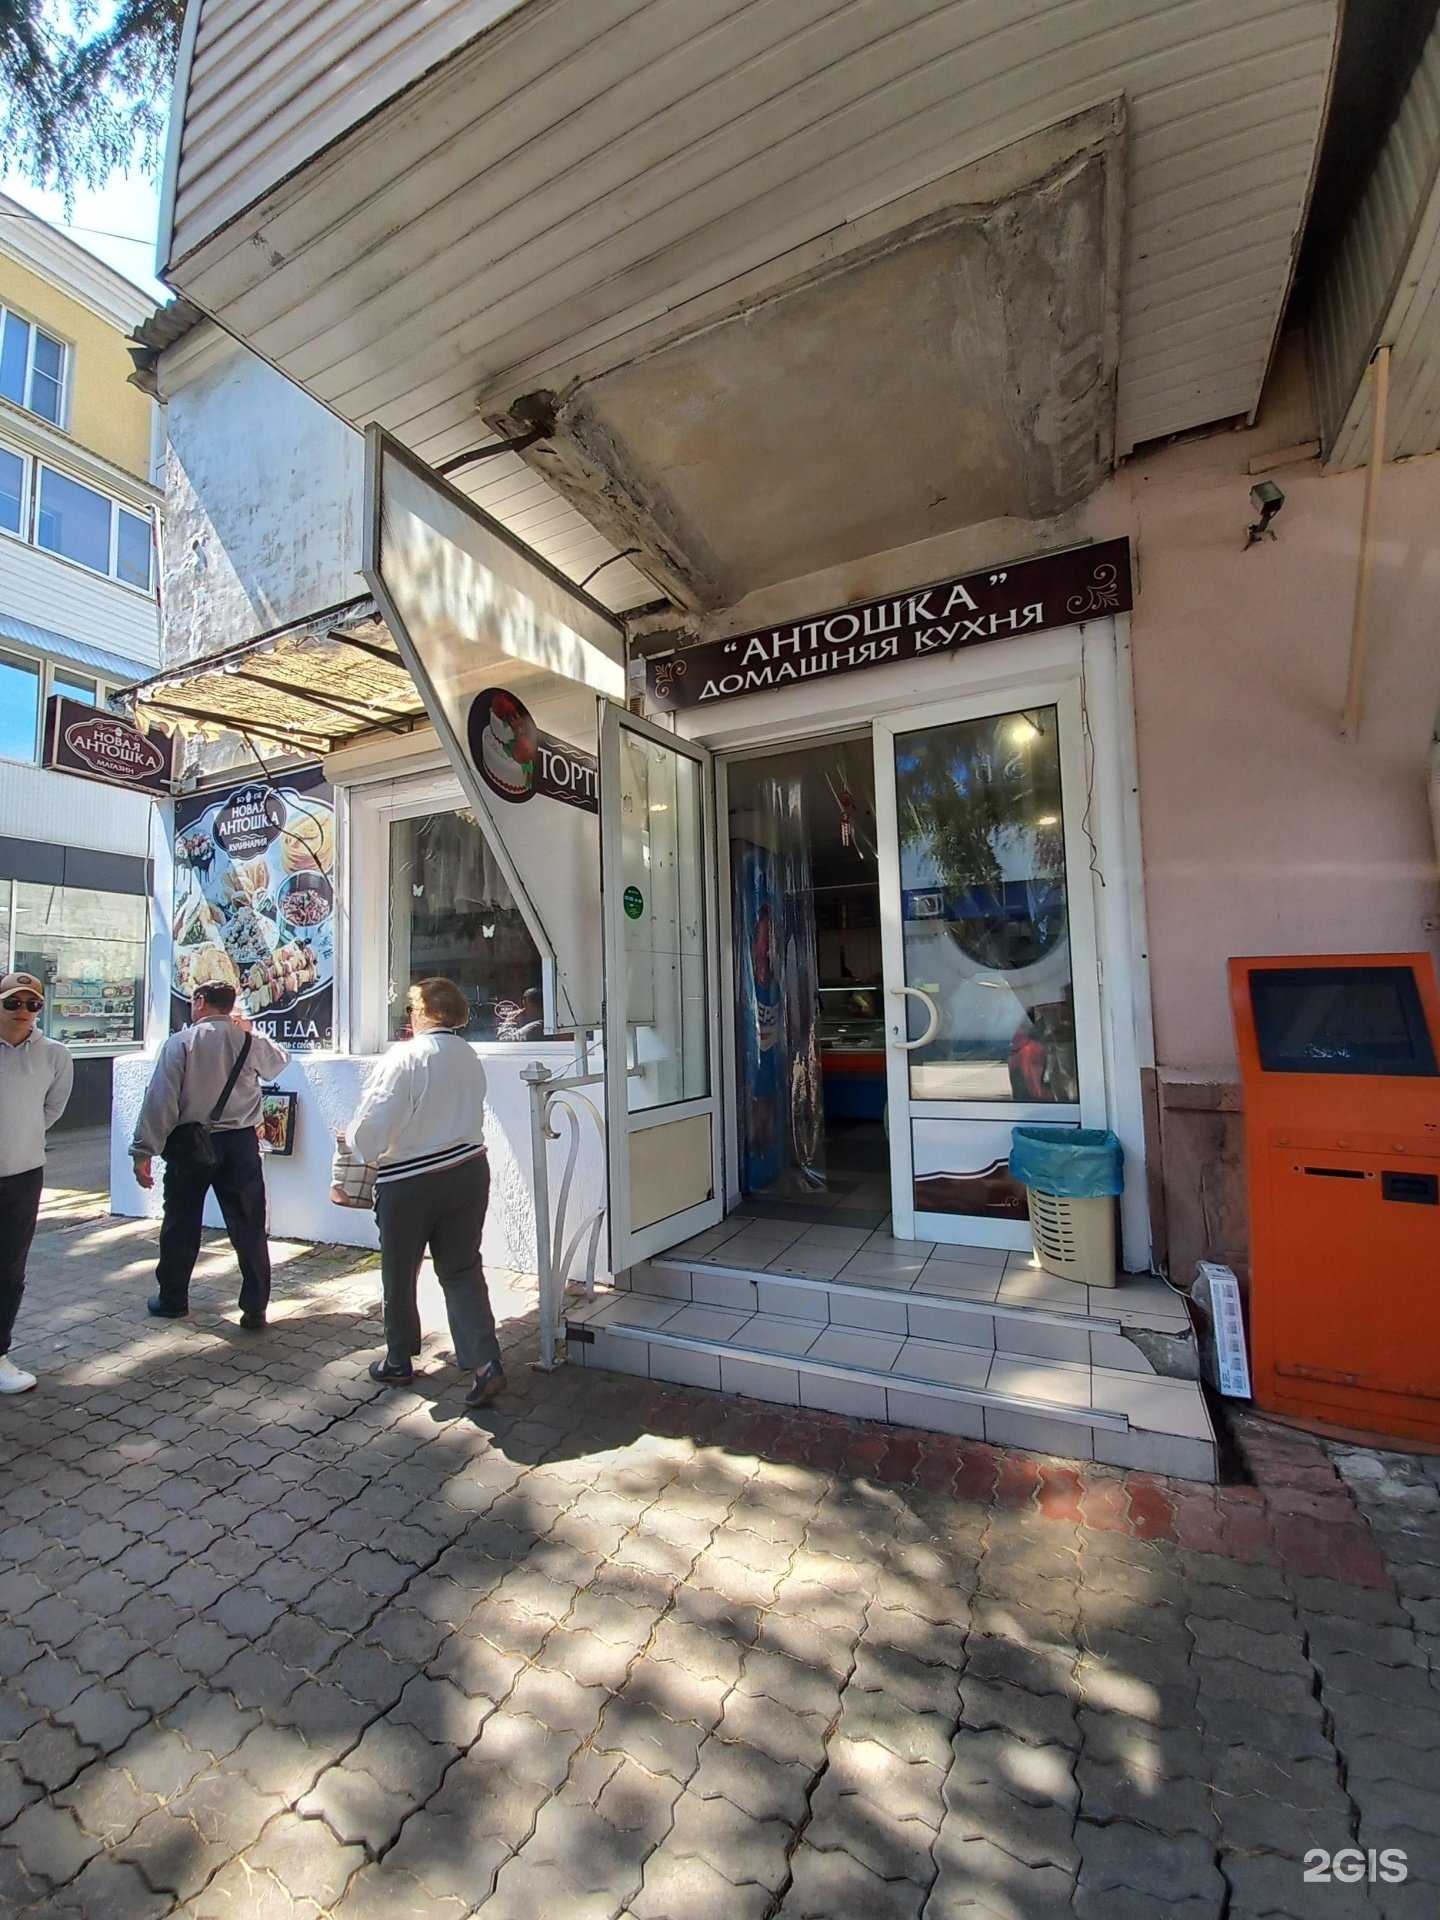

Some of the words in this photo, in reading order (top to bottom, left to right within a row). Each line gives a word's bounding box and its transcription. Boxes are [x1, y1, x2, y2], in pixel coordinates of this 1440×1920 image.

[699, 635, 899, 700] ДОМАШНЯЯ
[914, 602, 1044, 651] КУХНЯ
[73, 735, 157, 768] АНТОШКА
[93, 730, 141, 752] НОВАЯ
[96, 759, 135, 775] МАГАЗИН
[232, 801, 266, 819] НОВАЯ
[219, 811, 280, 836] АНТОШКА
[283, 1020, 320, 1038] ЕДА
